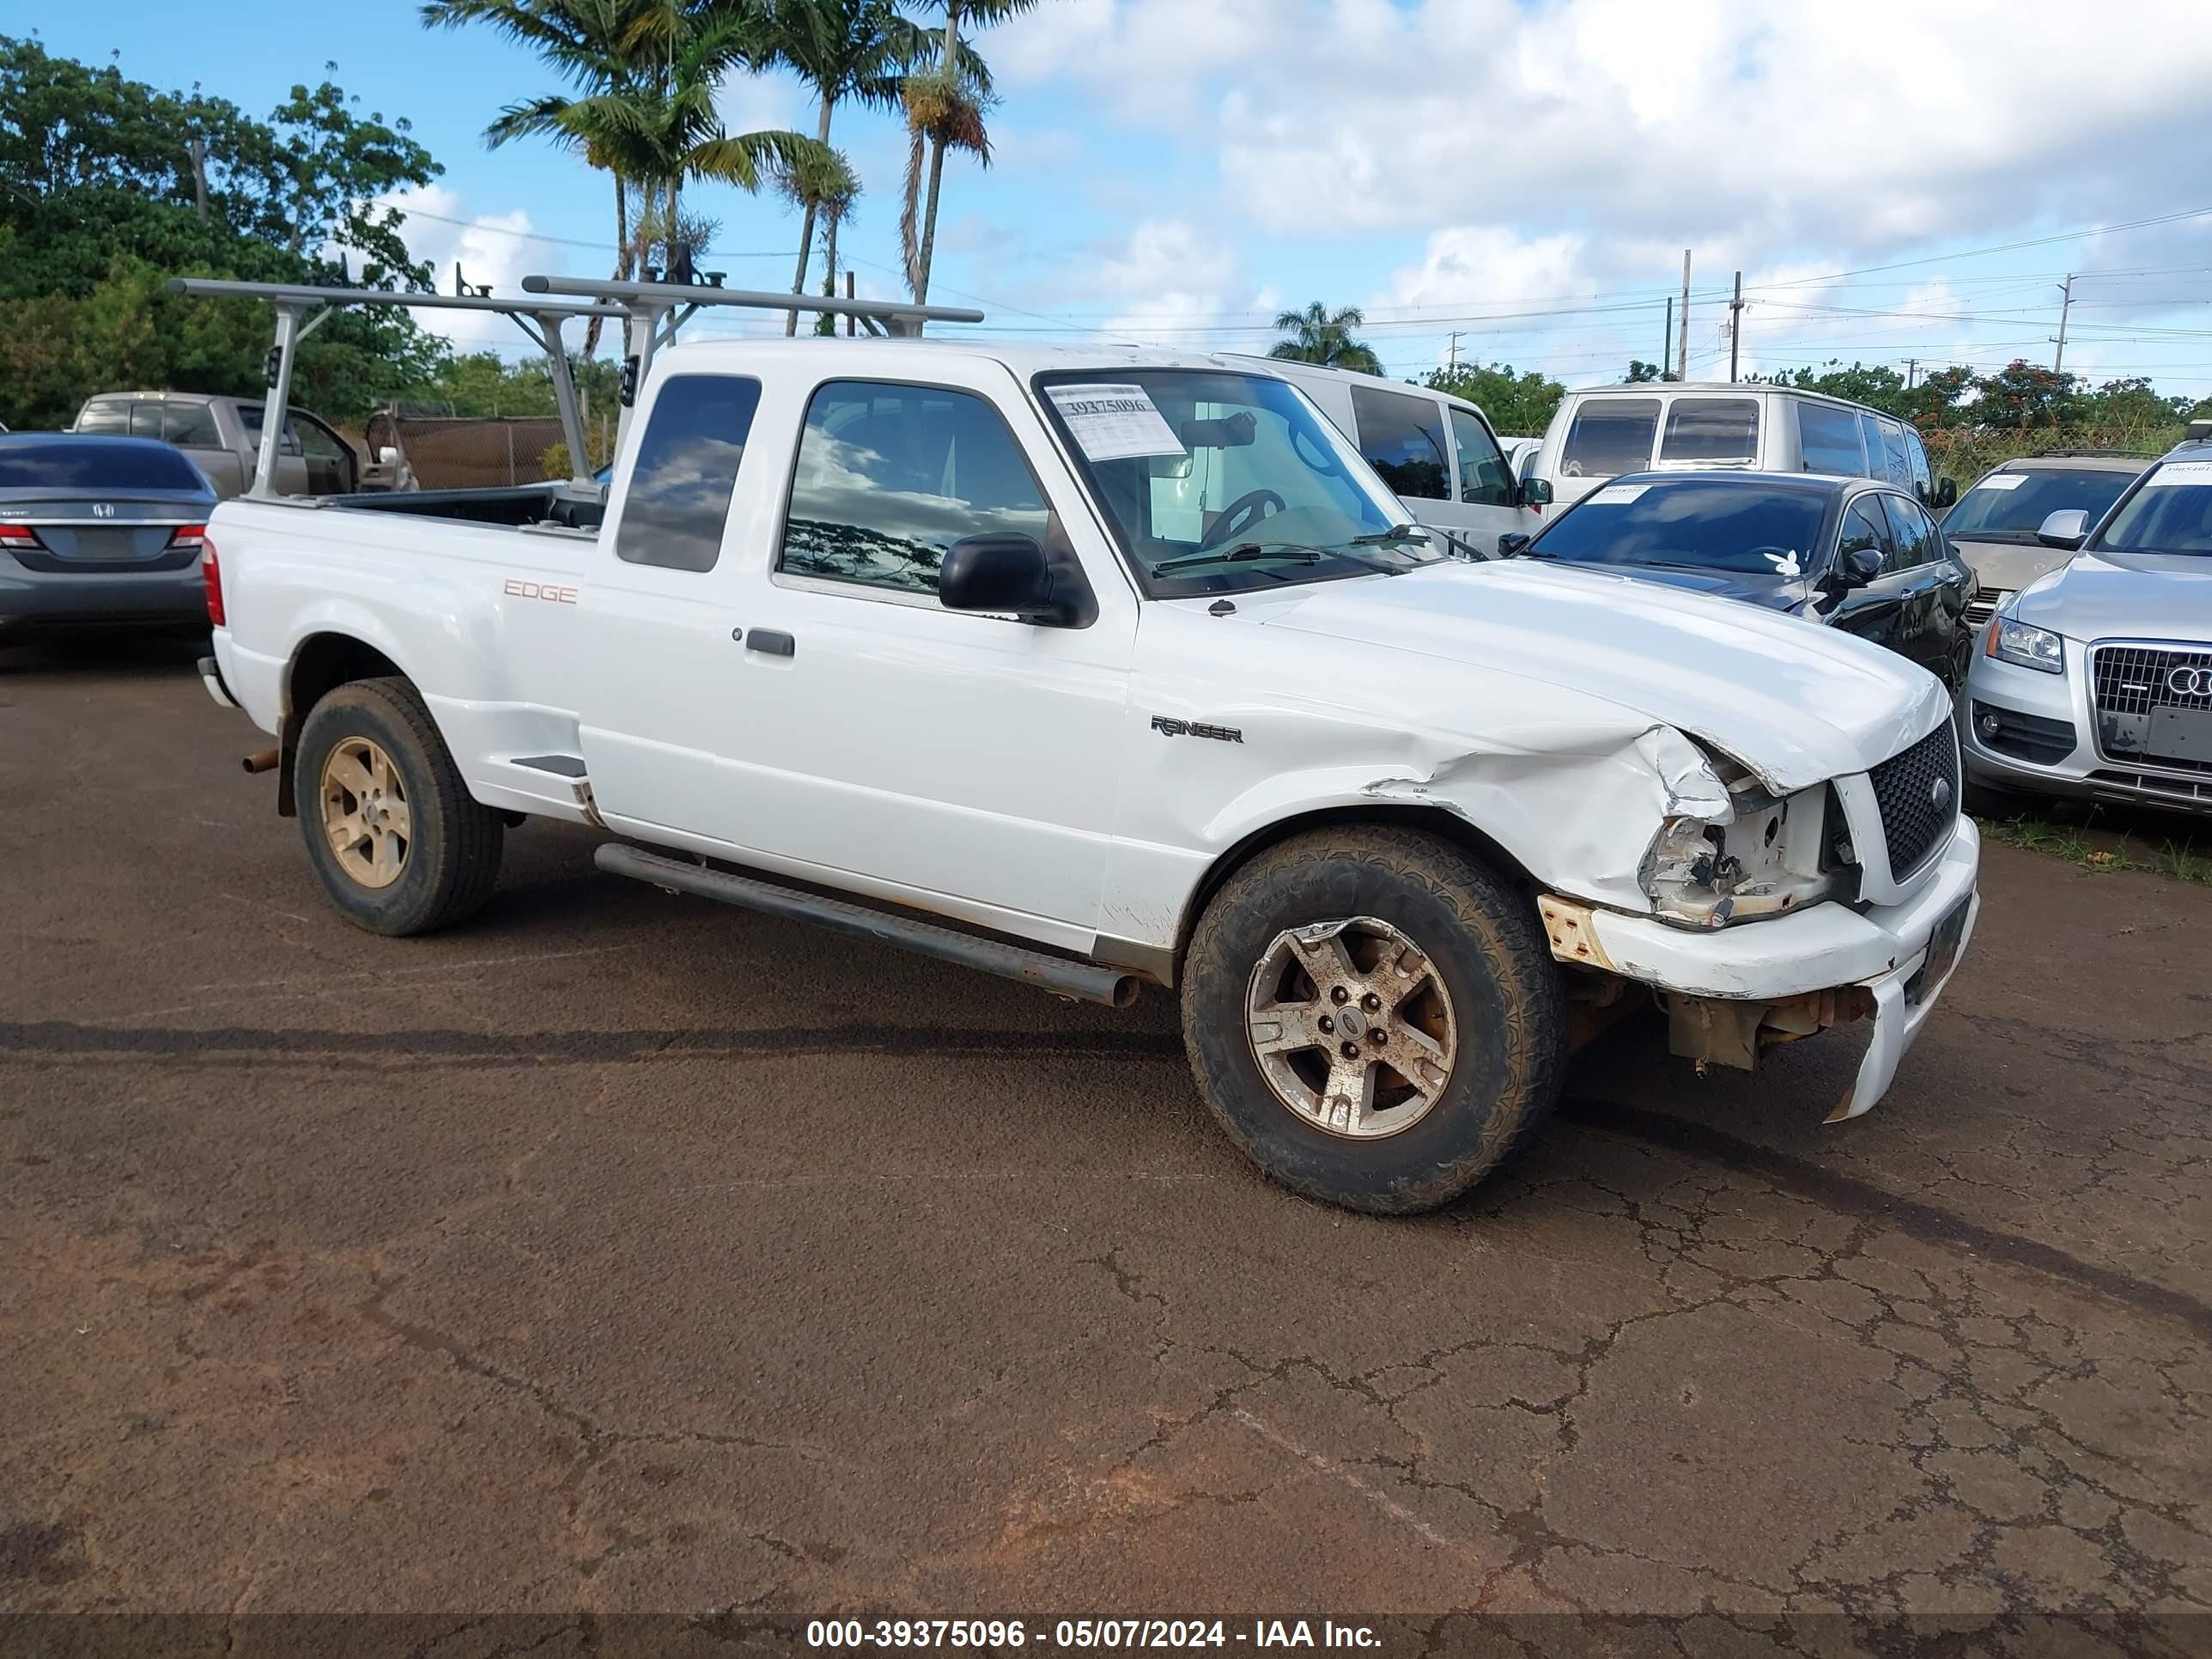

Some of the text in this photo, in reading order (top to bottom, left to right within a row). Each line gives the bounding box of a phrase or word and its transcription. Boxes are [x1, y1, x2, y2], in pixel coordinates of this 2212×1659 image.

[1066, 399, 1146, 415] 39375096
[504, 580, 578, 605] EDGE
[1151, 714, 1244, 744] RANGER
